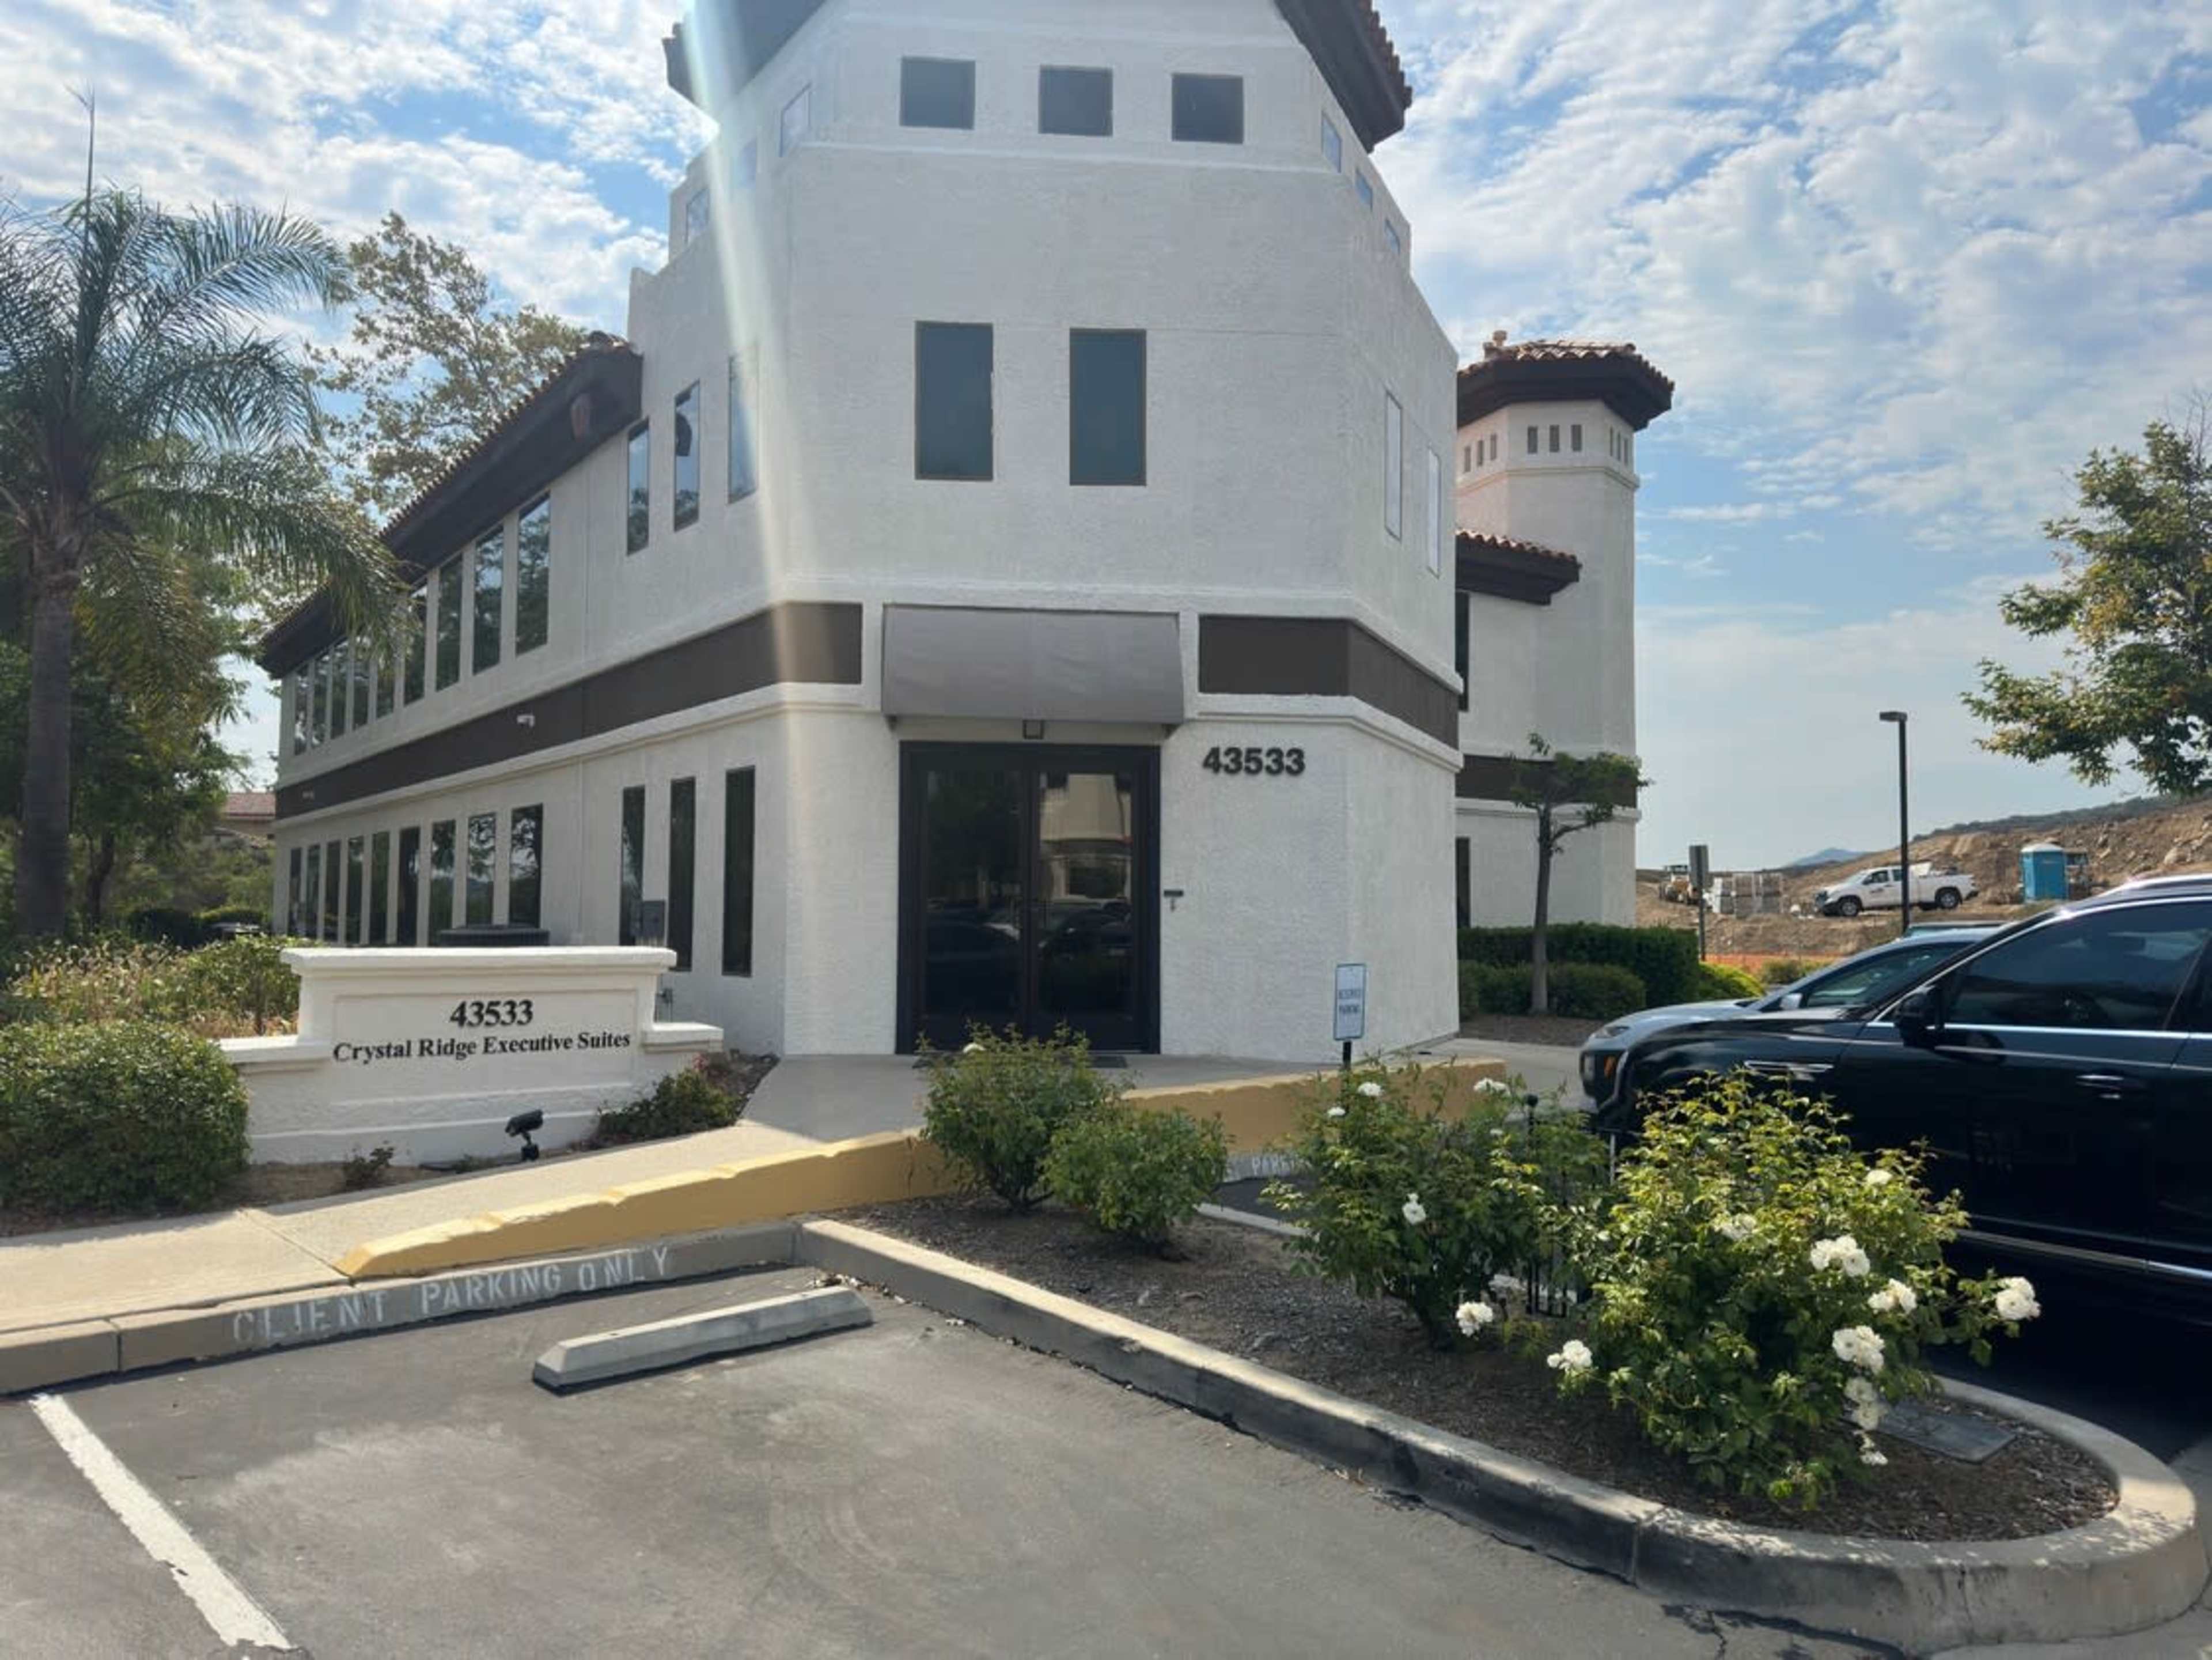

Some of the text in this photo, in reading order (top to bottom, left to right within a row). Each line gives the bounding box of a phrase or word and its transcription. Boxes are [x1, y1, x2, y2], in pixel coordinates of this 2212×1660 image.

[1202, 747, 1305, 776] 43533
[449, 999, 533, 1027] 43533
[333, 1031, 631, 1065] Crystal Ridge Executive Suites
[233, 1246, 668, 1341] CLIENT PARKING ONLY
